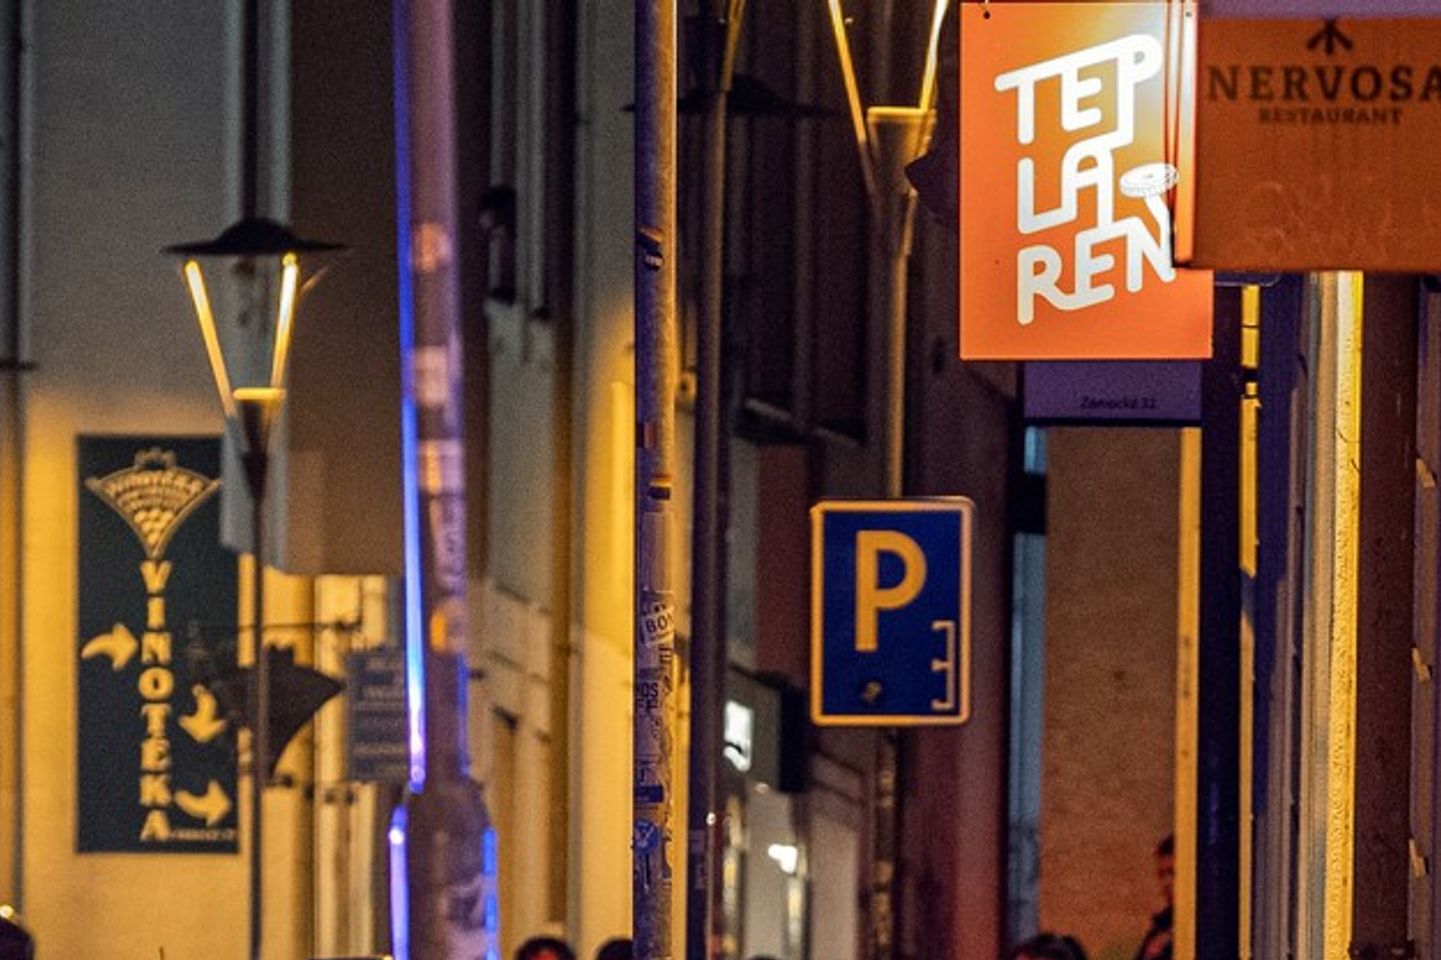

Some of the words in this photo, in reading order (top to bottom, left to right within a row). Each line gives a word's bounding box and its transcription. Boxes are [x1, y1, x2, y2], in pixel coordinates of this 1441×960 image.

[994, 34, 1162, 145] TEP
[1208, 64, 1441, 102] NERVOSA
[1259, 107, 1403, 125] RESTAURANT
[1017, 141, 1114, 235] LA
[1017, 216, 1176, 326] REN
[855, 529, 928, 653] P
[139, 560, 174, 841] VINOTEKA
